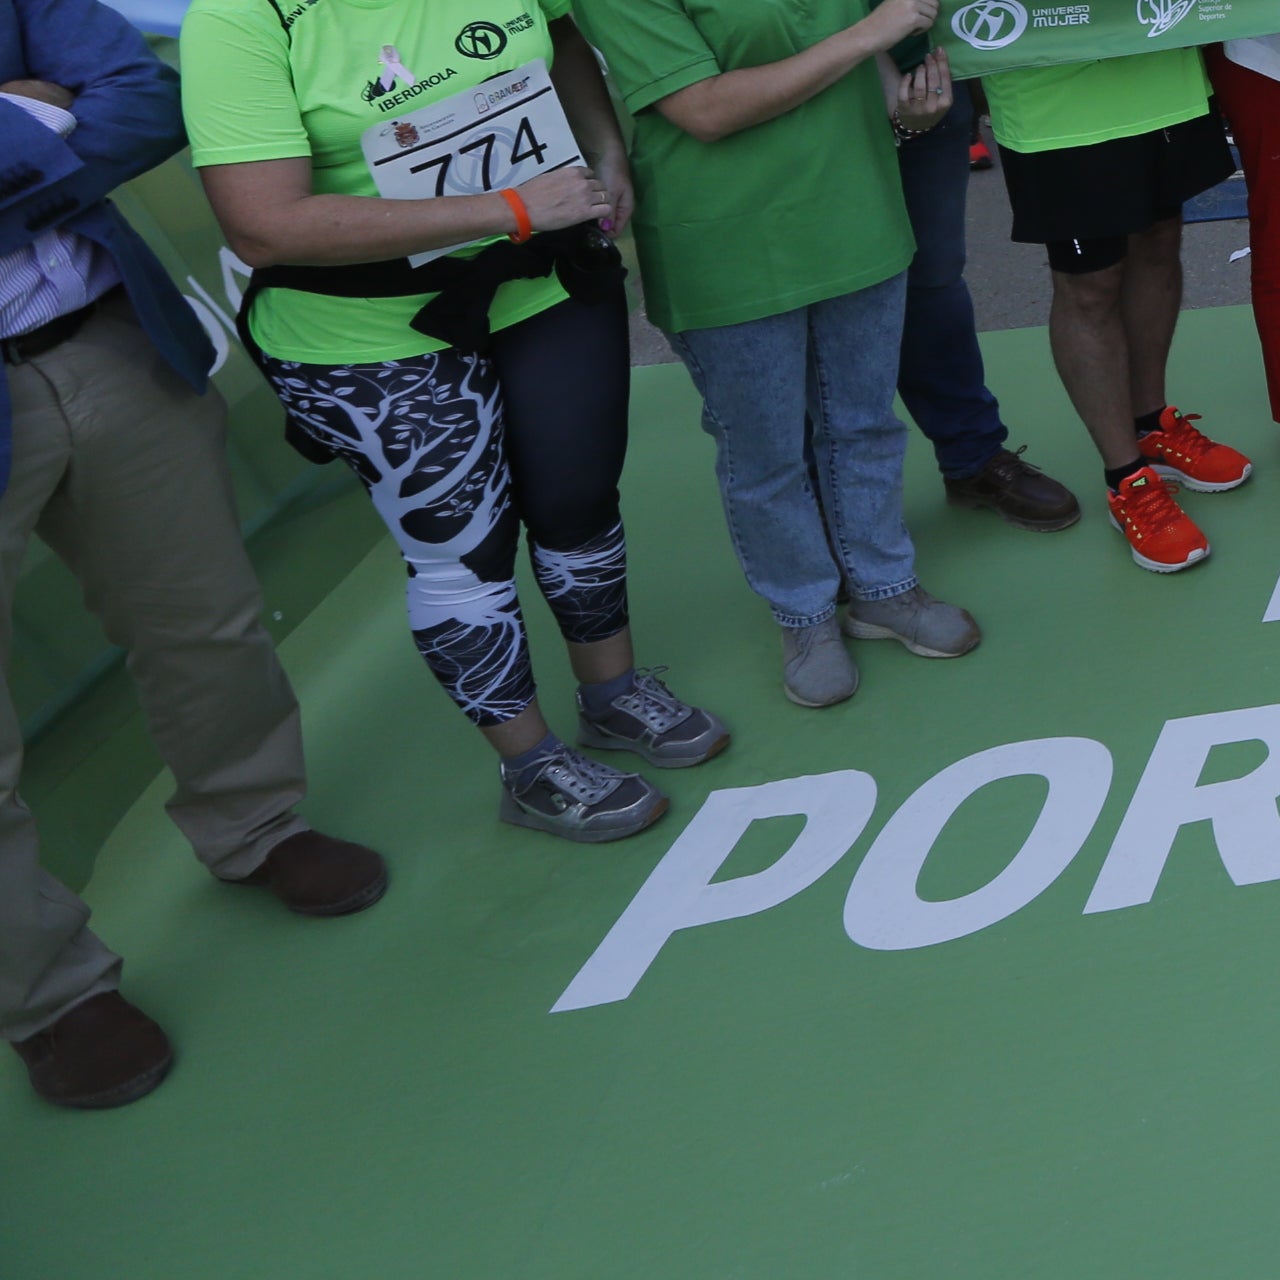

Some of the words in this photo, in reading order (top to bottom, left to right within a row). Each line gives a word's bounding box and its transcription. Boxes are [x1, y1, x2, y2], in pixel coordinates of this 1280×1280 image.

[1032, 4, 1090, 17] UNIVERSO
[1198, 4, 1223, 12] Superior
[1224, 3, 1232, 11] de
[1033, 14, 1090, 28] MUJER
[1199, 12, 1226, 21] Deportes
[377, 67, 458, 113] IBERDROLA
[409, 116, 548, 197] 774
